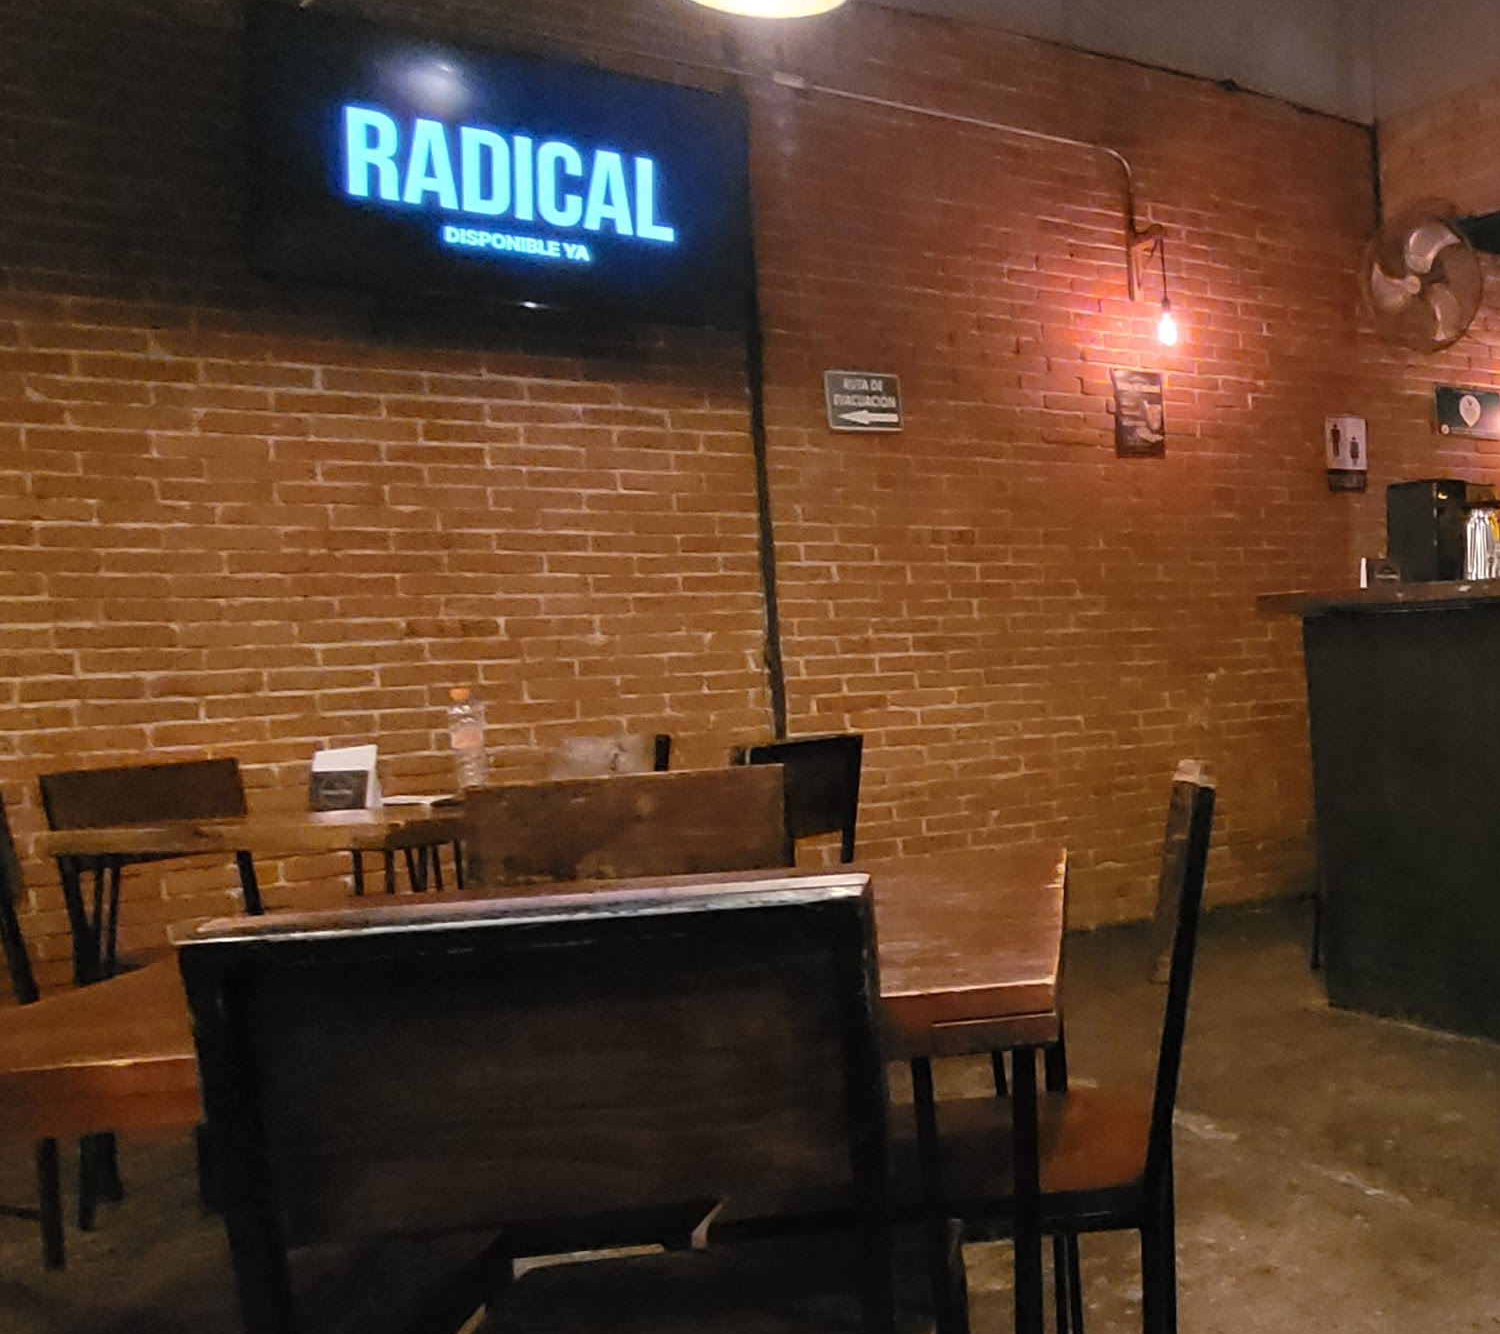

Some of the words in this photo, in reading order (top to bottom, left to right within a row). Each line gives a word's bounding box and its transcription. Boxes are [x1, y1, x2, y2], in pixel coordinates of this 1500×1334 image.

[344, 105, 675, 243] RADICAL
[443, 225, 561, 259] DISPONIBLE
[562, 242, 591, 262] YA
